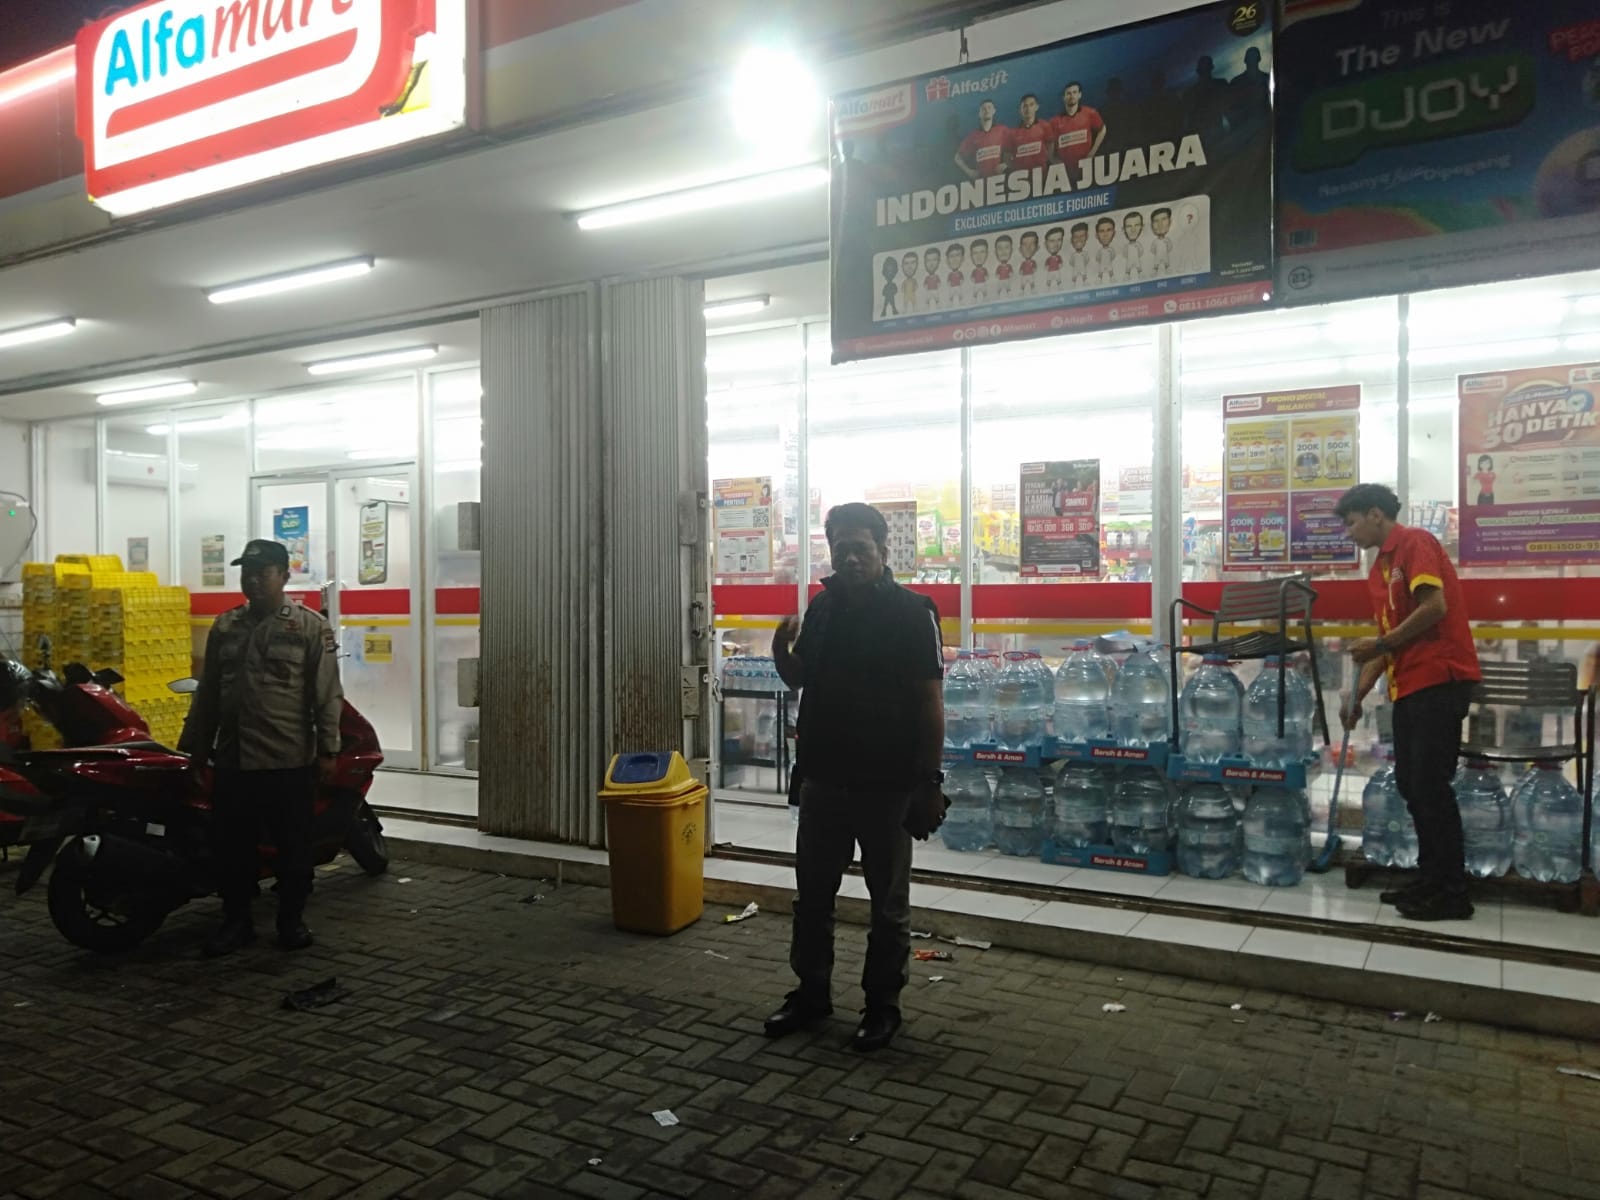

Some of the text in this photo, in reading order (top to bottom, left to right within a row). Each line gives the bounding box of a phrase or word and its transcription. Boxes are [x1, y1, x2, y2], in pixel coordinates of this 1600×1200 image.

[1231, 3, 1257, 26] 26
[1336, 18, 1513, 76] The New
[950, 70, 1009, 97] Alfagift
[1322, 65, 1519, 141] DJOY
[876, 133, 1207, 228] INDONESIA JUARA
[955, 192, 1110, 232] EXCLUSIVE COLLECTIBLE FIGURINE
[1487, 399, 1568, 428] HANYA
[1526, 411, 1600, 434] DETIK
[1003, 753, 1024, 761] Aman
